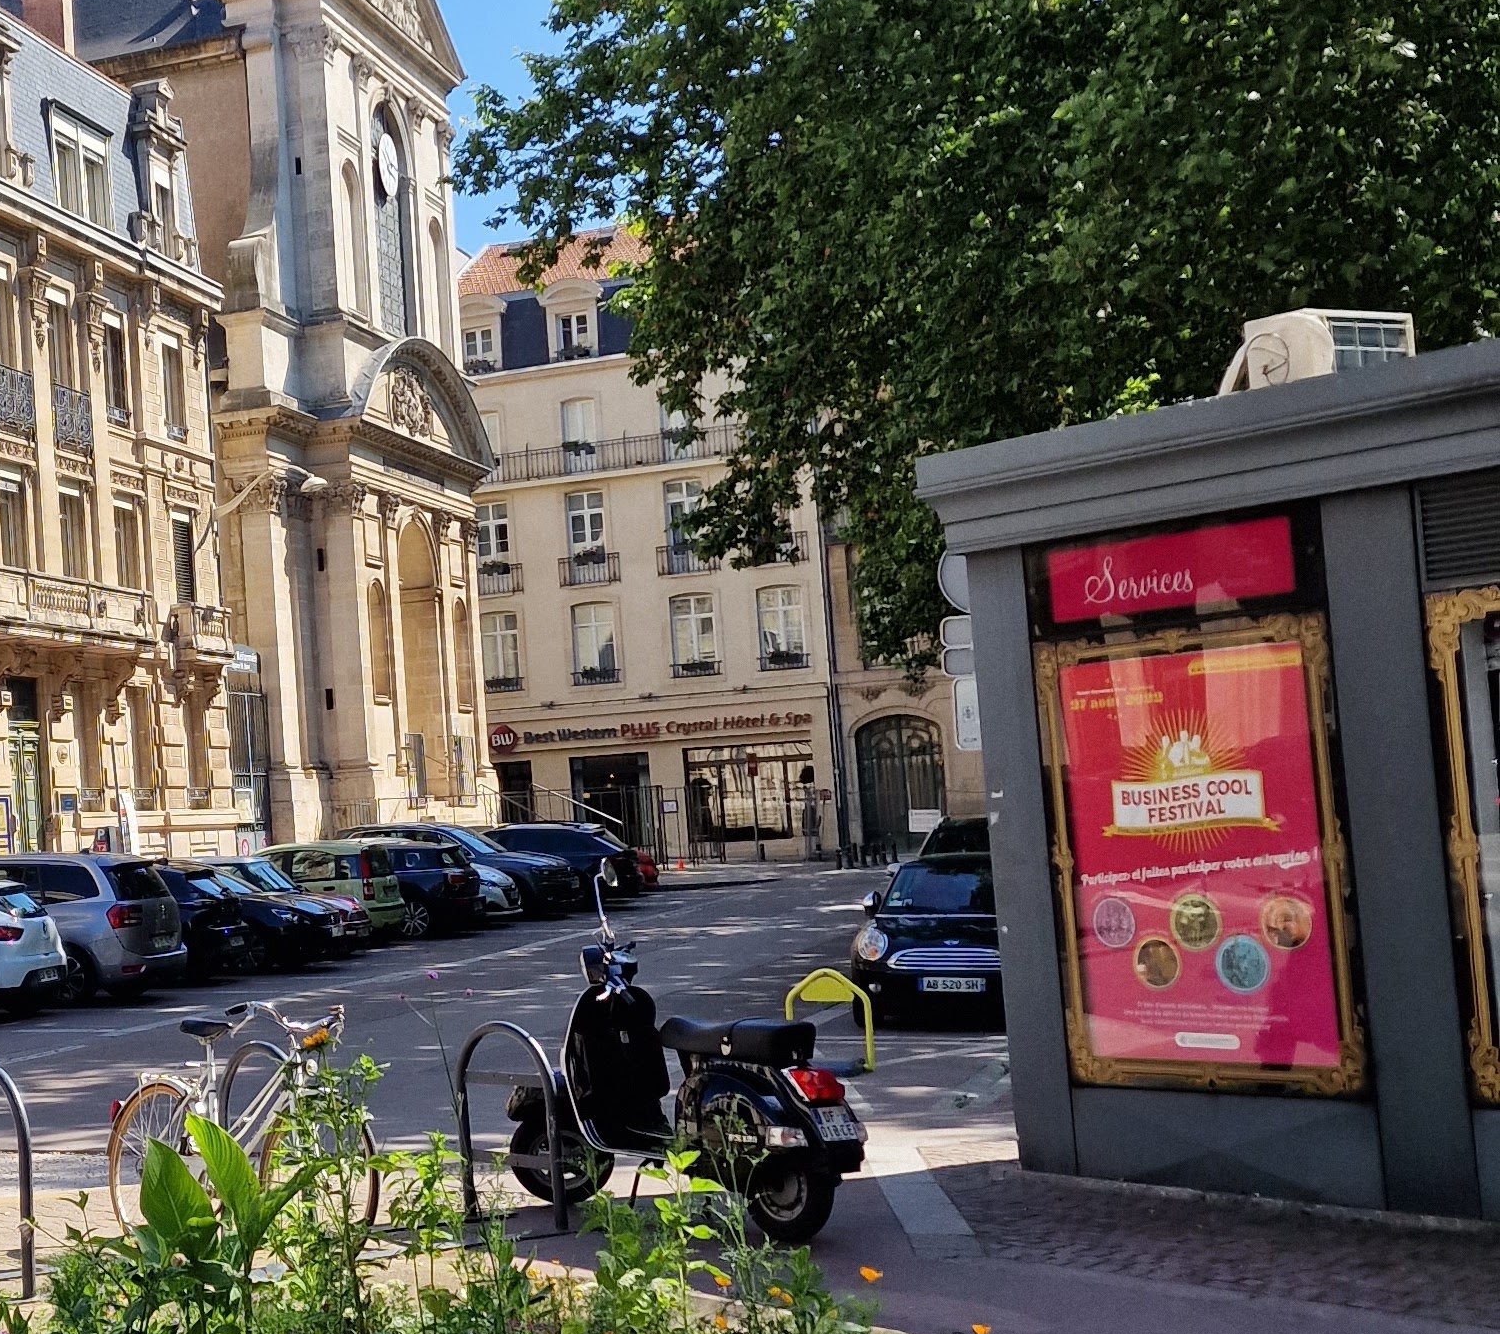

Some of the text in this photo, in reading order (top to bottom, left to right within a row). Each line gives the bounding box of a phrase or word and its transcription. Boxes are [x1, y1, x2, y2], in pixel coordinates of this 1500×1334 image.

[1083, 555, 1194, 605] Services
[491, 732, 514, 747] BW
[523, 711, 813, 744] Best Western PLUS Crystal Hôtel & Spa
[1120, 779, 1252, 807] BUSINESS COOL
[1148, 798, 1226, 824] FESTIVAL
[97, 828, 106, 841] P
